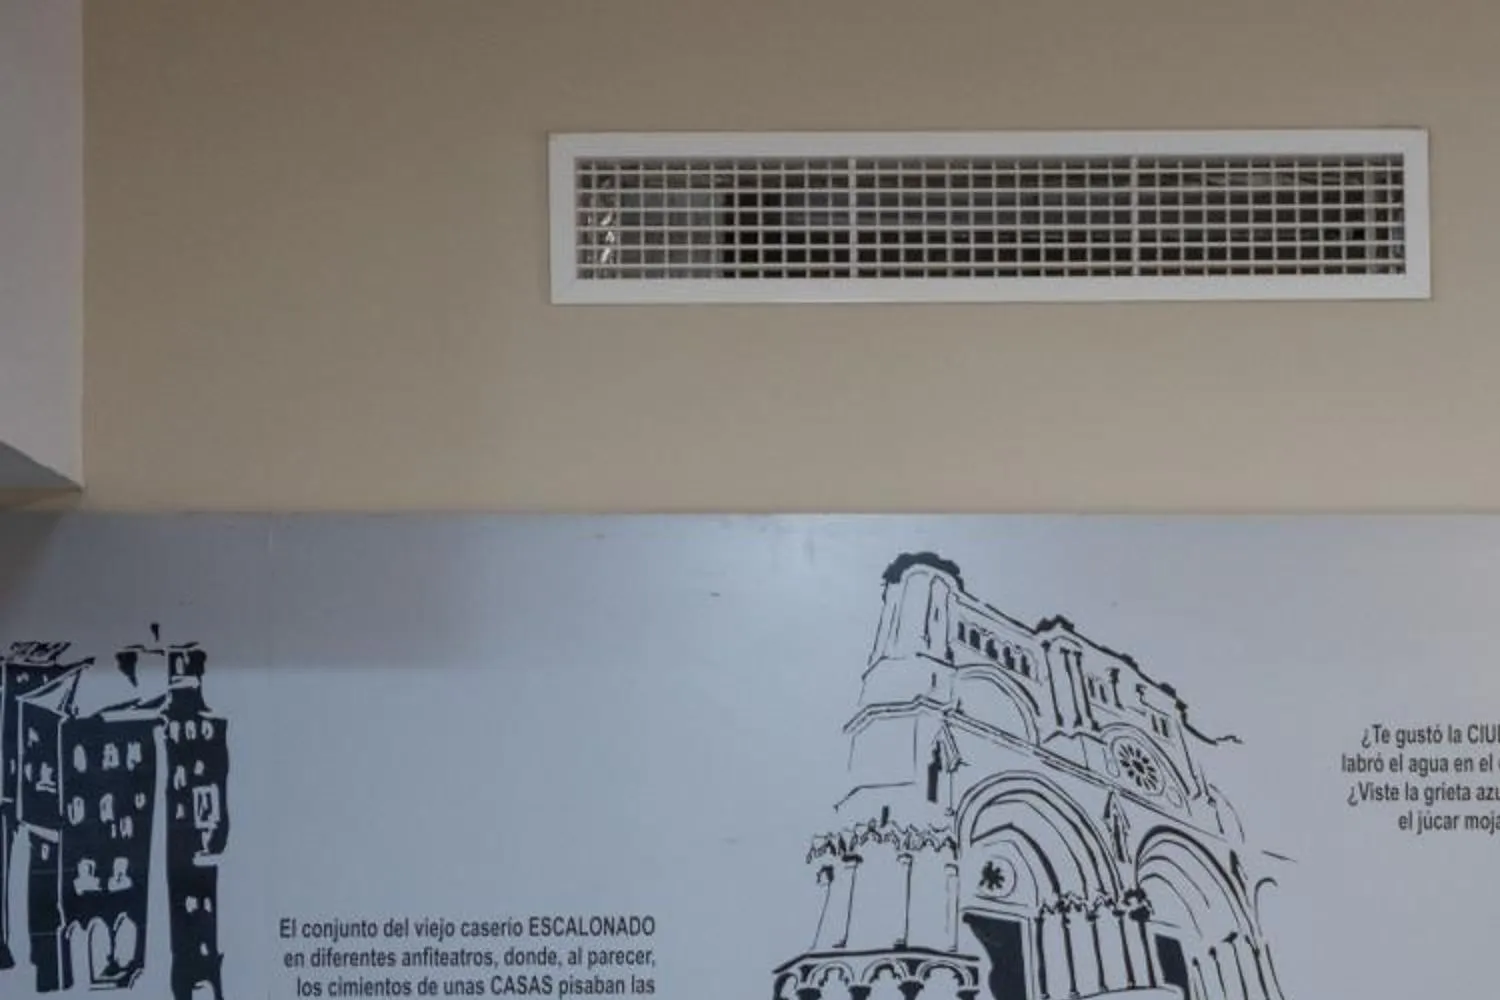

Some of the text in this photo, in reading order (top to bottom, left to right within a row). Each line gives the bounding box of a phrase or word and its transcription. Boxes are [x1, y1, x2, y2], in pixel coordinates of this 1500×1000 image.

[1361, 724, 1390, 749] ¿Te
[1396, 723, 1443, 749] gustó
[1448, 724, 1462, 744] la
[1342, 753, 1384, 772] labró
[1389, 753, 1403, 772] el
[1408, 757, 1448, 777] agua
[1454, 757, 1473, 772] en
[1479, 753, 1493, 772] el
[1347, 782, 1400, 806] ¿Viste
[1405, 782, 1419, 801] la
[1424, 782, 1471, 806] grieta
[1398, 810, 1412, 830] el
[280, 918, 296, 938] El
[302, 917, 378, 943] conjunto
[383, 917, 409, 937] del
[414, 917, 455, 942] viejo
[529, 915, 655, 937] ESCALONADO
[284, 946, 655, 970] en diferentes anfiteatros, donde, al parecer,
[297, 975, 655, 1000] los cimientos de unas CASAS pisaban las
